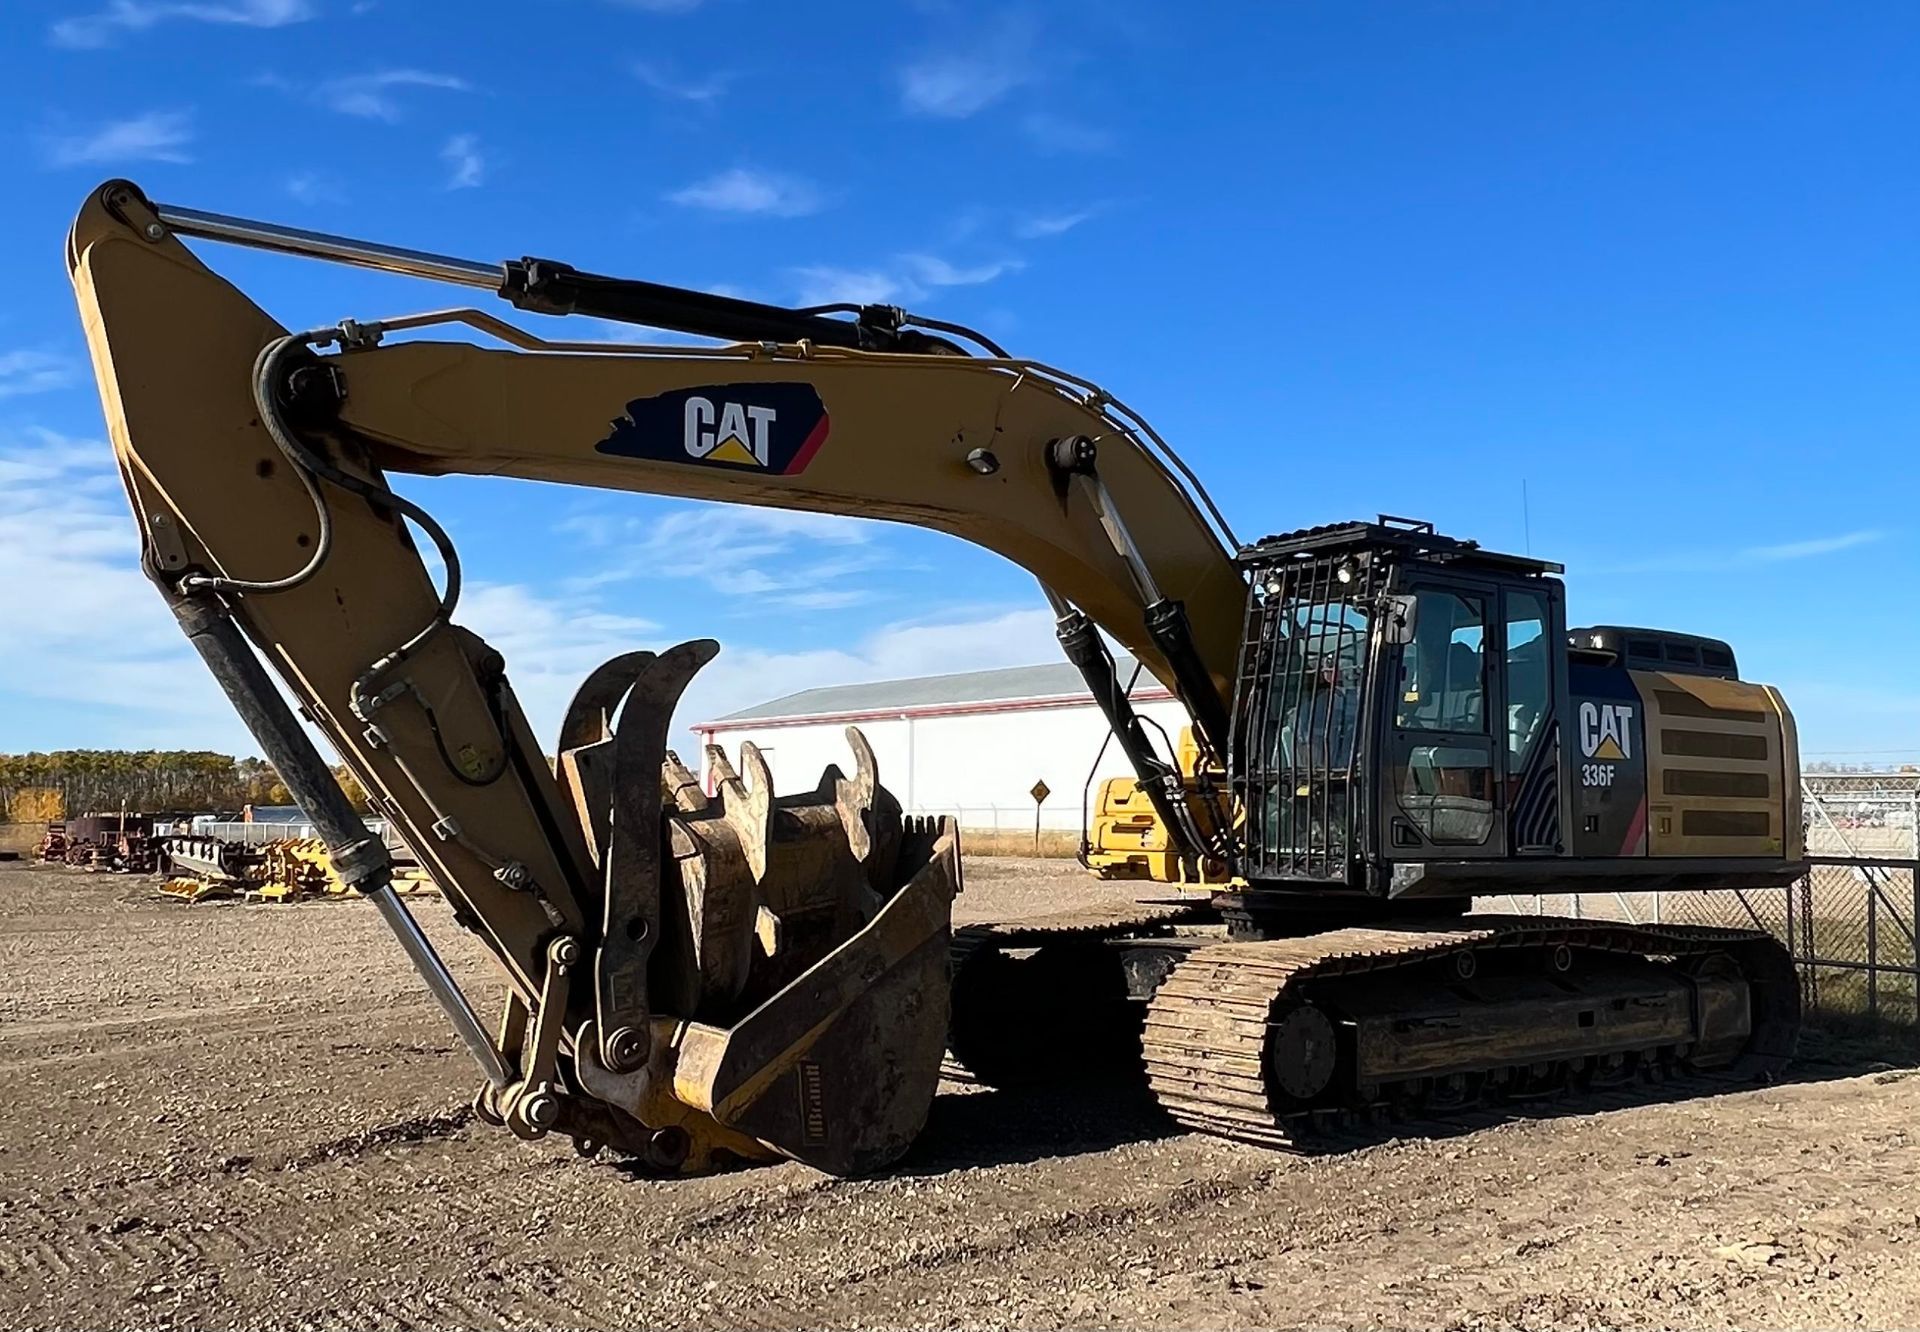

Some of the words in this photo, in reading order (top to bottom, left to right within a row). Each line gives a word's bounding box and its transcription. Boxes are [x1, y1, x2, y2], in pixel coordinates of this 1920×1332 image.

[684, 396, 777, 467] CAT
[1580, 702, 1633, 759] CAT
[1581, 764, 1615, 786] 336F
